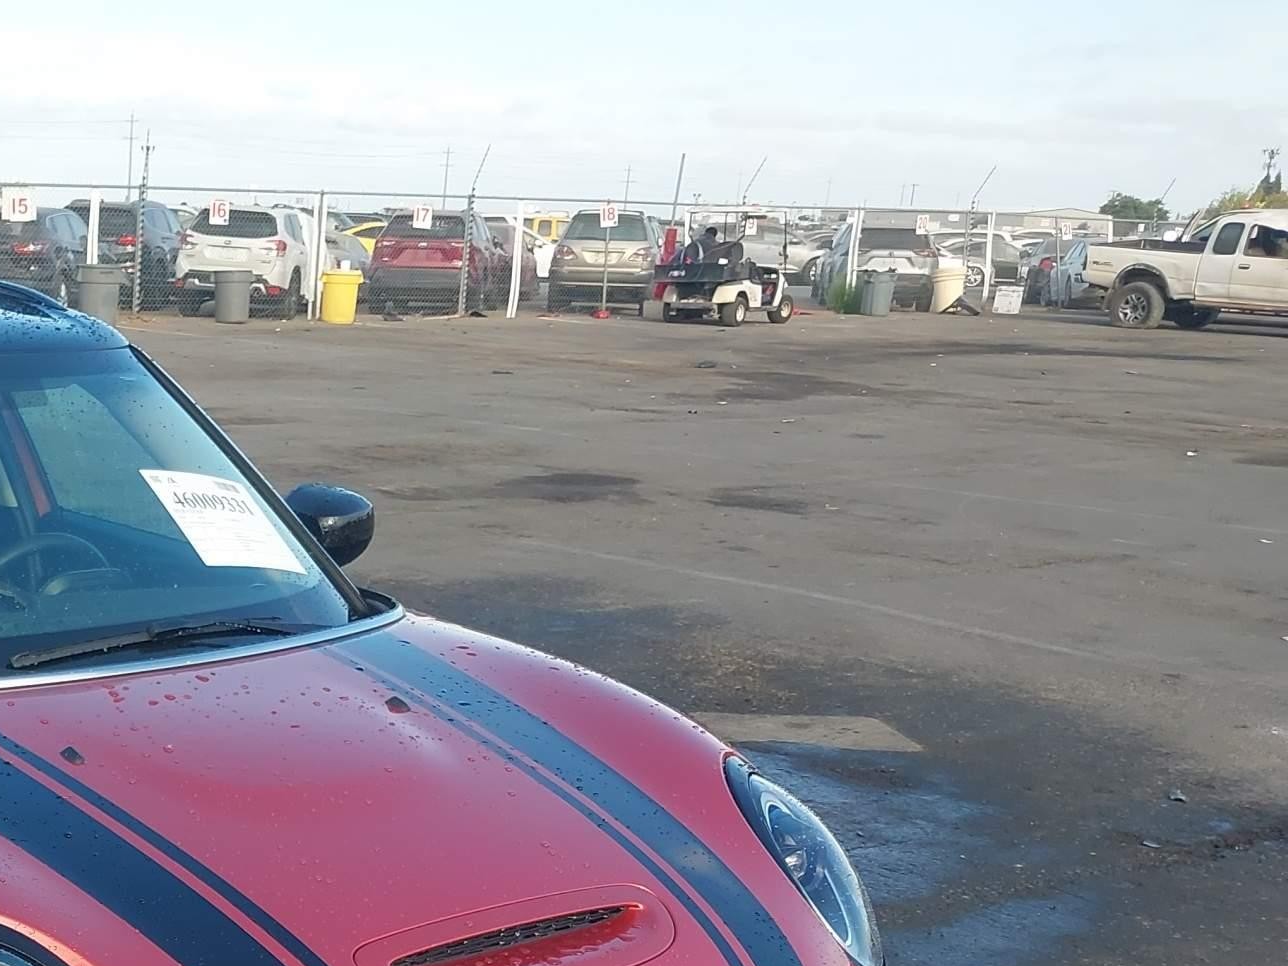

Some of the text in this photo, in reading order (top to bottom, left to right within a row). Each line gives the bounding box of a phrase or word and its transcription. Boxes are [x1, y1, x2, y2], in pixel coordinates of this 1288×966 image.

[11, 198, 28, 215] 15
[212, 202, 227, 218] 16
[415, 207, 430, 221] 17
[601, 206, 616, 221] 18
[173, 490, 255, 516] 46009331
